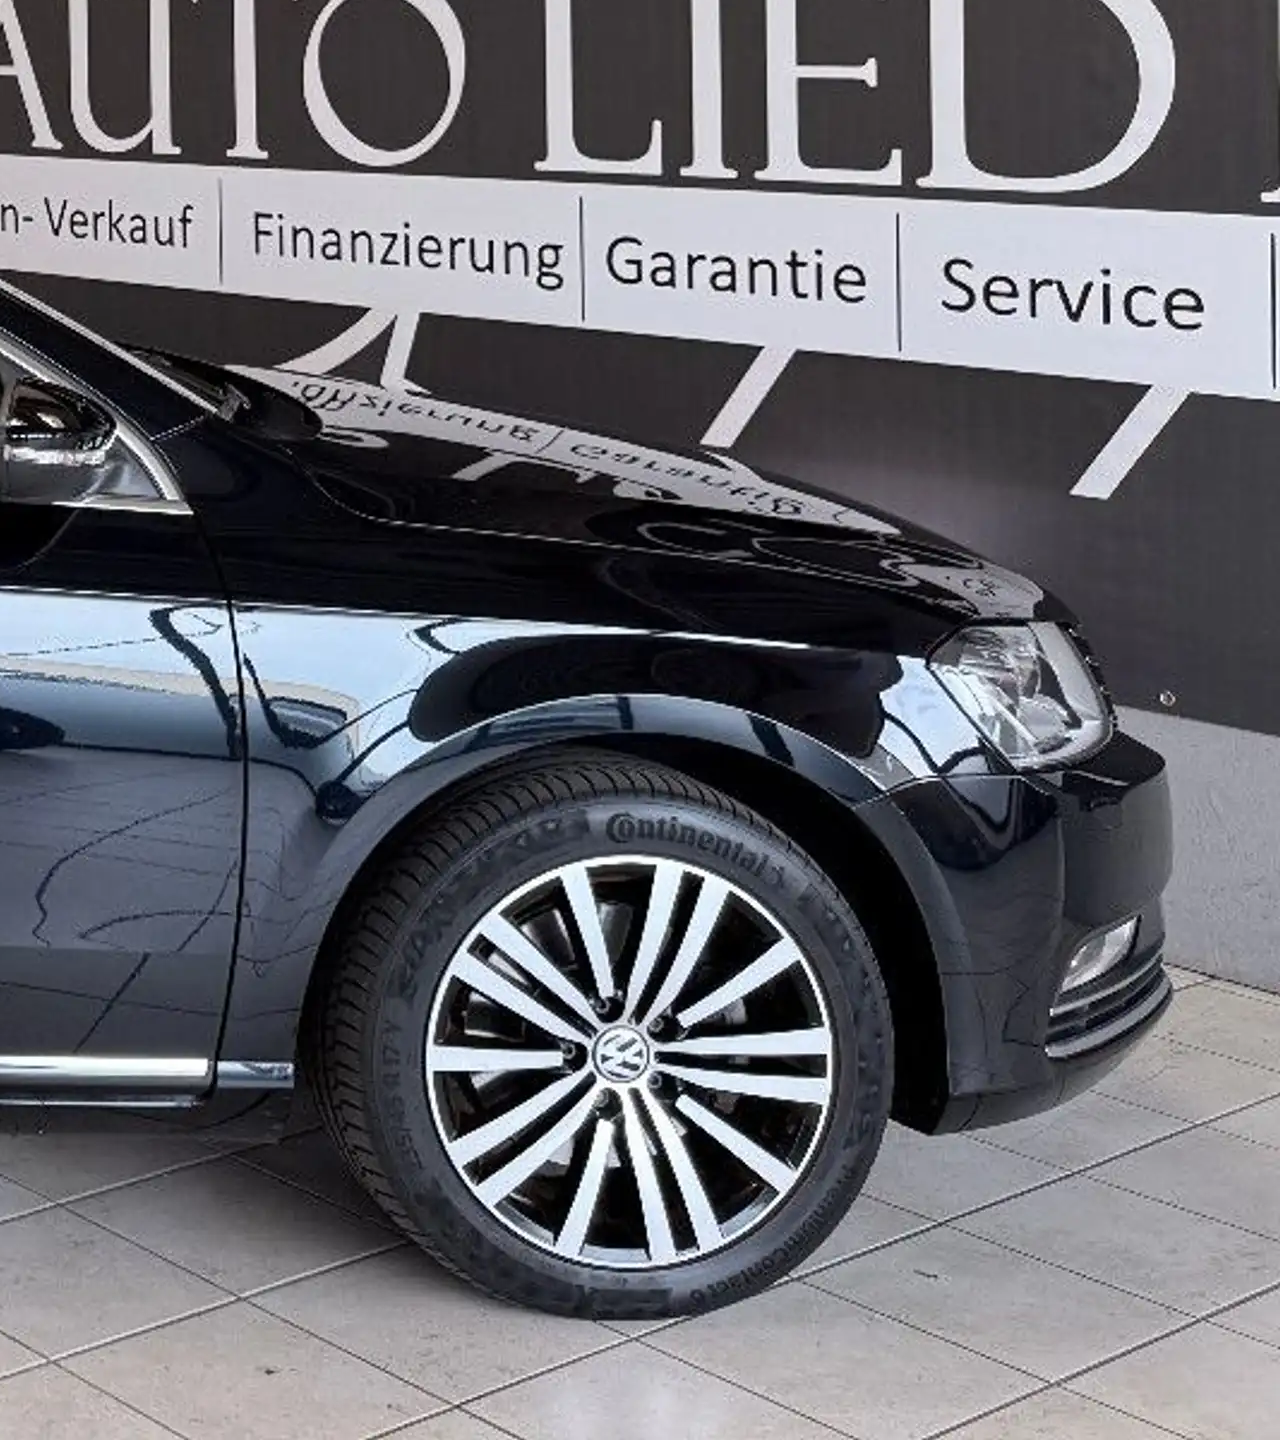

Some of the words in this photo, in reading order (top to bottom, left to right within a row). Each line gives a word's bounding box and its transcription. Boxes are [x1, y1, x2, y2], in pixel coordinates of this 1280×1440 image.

[43, 196, 194, 248] Verkauf
[254, 212, 565, 292] Finanzierung
[606, 236, 868, 304] Garantie
[941, 258, 1205, 331] Service
[605, 810, 770, 877] Continental
